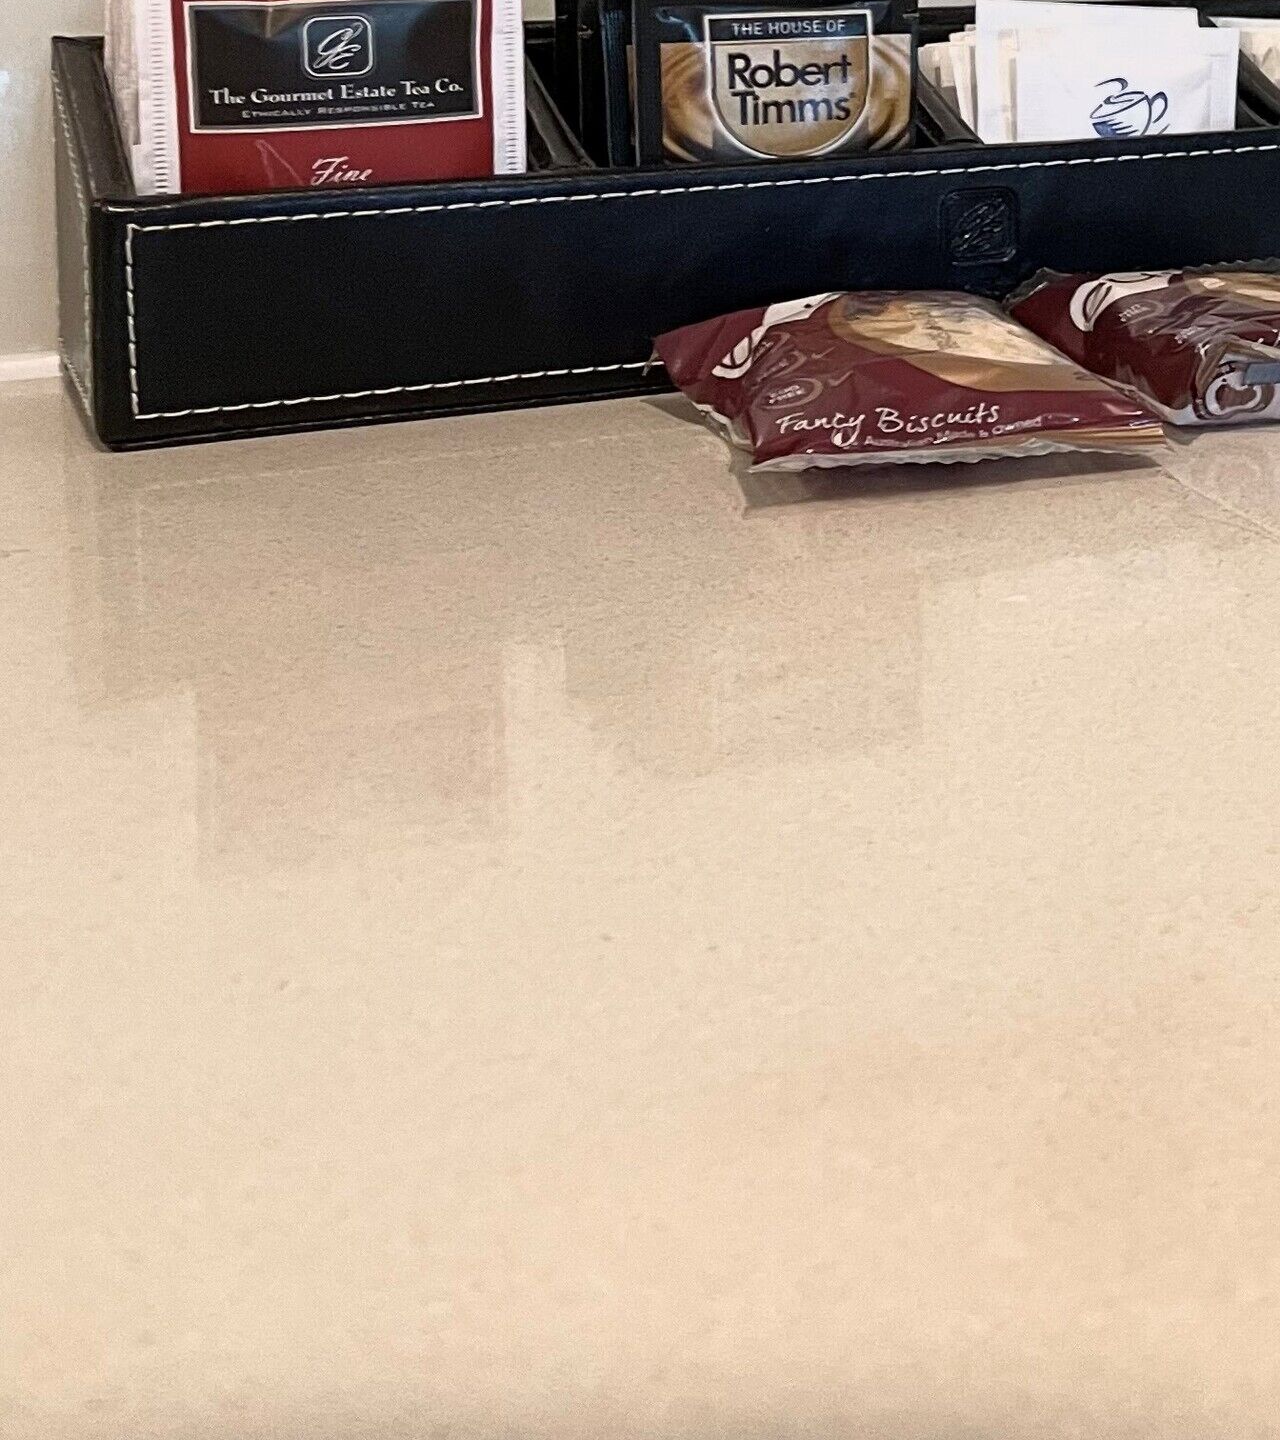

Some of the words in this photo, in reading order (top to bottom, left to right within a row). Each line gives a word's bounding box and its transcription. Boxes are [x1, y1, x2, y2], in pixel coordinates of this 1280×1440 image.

[730, 21, 764, 36] THE
[768, 19, 822, 35] HOUSE
[825, 18, 847, 33] OF
[727, 48, 853, 90] Robert
[208, 86, 246, 105] The
[250, 87, 335, 105] Gourmet
[340, 83, 397, 100] Estate
[400, 80, 431, 96] Tea
[434, 77, 464, 94] Co.
[730, 89, 852, 126] Timms
[309, 155, 374, 187] Fine
[774, 411, 867, 447] Fancy
[873, 402, 1001, 434] Biscuits
